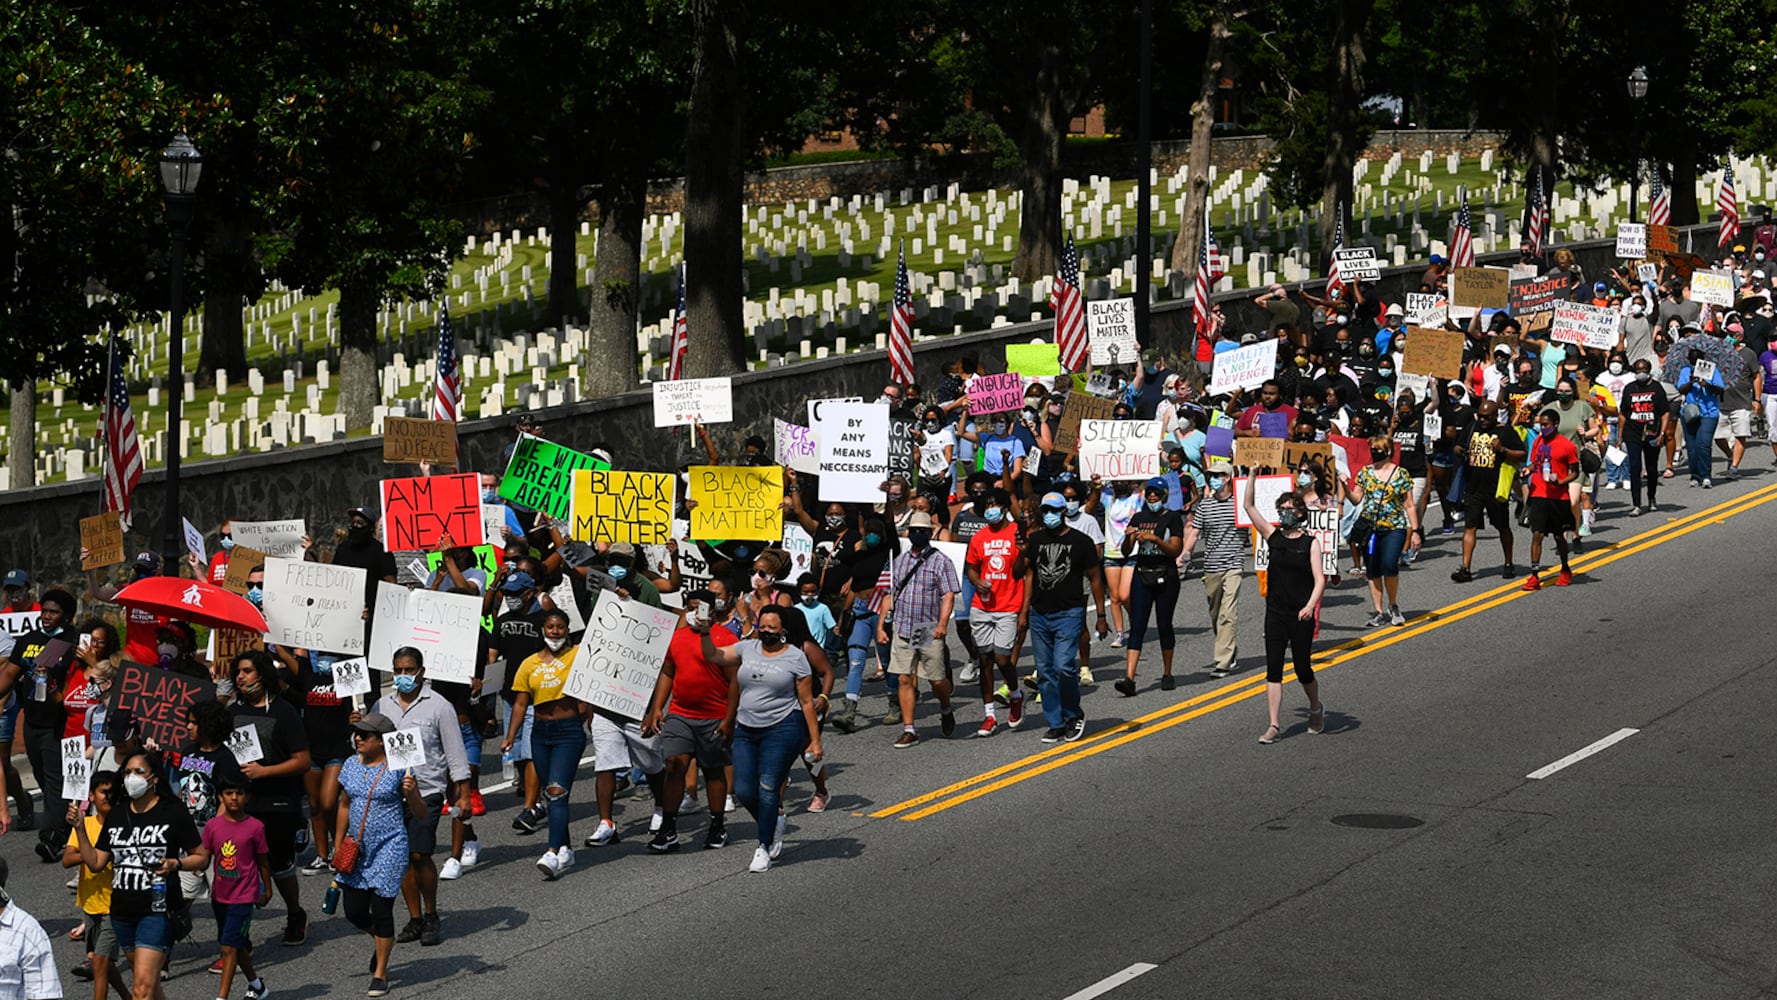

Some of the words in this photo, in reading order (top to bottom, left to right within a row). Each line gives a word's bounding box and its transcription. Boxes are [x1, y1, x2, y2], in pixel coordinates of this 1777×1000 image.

[1340, 250, 1370, 260] BLACK
[1340, 269, 1379, 280] MATTER
[1344, 261, 1370, 269] LIVES
[1465, 281, 1494, 290] TAYLOR
[1511, 276, 1568, 298] INJUSTICE
[1694, 274, 1731, 290] ASIAN
[1092, 302, 1128, 316] BLACK
[1557, 309, 1589, 322] NOTHING
[1097, 313, 1125, 325] LIVES
[1096, 325, 1129, 337] MATTER
[1551, 327, 1590, 342] ANYTHING
[1217, 345, 1273, 367] EQUALITY
[1231, 360, 1253, 373] NOT
[968, 373, 1020, 394] ENOUGH
[1217, 366, 1269, 388] REVENGE
[659, 381, 702, 393] INJUSTICE
[667, 400, 701, 413] JUSTICE
[970, 391, 1021, 413] ENOUGH
[389, 420, 409, 437] NO
[411, 421, 446, 439] JUSTICE
[848, 419, 863, 427] BY
[1084, 421, 1159, 441] SILENCE
[841, 433, 865, 442] ANY
[1106, 440, 1127, 454] IS
[1260, 442, 1281, 450] LIVES
[394, 440, 414, 457] NO
[416, 440, 449, 457] PEACE
[517, 437, 544, 460] WE
[833, 448, 871, 458] MEANS
[1244, 452, 1273, 460] MATTER
[820, 463, 888, 473] NECCESSARY
[1085, 454, 1157, 478] VIOLENCE
[591, 471, 669, 501] BLACK
[703, 471, 771, 492] BLACK
[386, 478, 433, 512] AM
[450, 475, 479, 510] I
[713, 491, 766, 509] LIVES
[595, 495, 670, 523] LIVES
[237, 525, 263, 535] WHITE
[265, 524, 297, 534] INACTION
[395, 510, 476, 549] NEXT
[576, 515, 669, 544] MATTER
[699, 509, 778, 531] MATTER
[286, 563, 355, 593] FREEDOM
[267, 591, 277, 603] TO
[291, 594, 305, 607] ME
[317, 598, 348, 611] MEANS
[382, 591, 472, 630] SILENCE
[500, 621, 539, 638] ATL
[598, 600, 662, 644] STOP
[283, 628, 328, 649] FEAR
[591, 629, 663, 670] PRETENDING
[586, 643, 626, 680] YOUR
[121, 667, 202, 706] BLACK
[117, 694, 190, 726] LIVES
[137, 716, 189, 749] TTER
